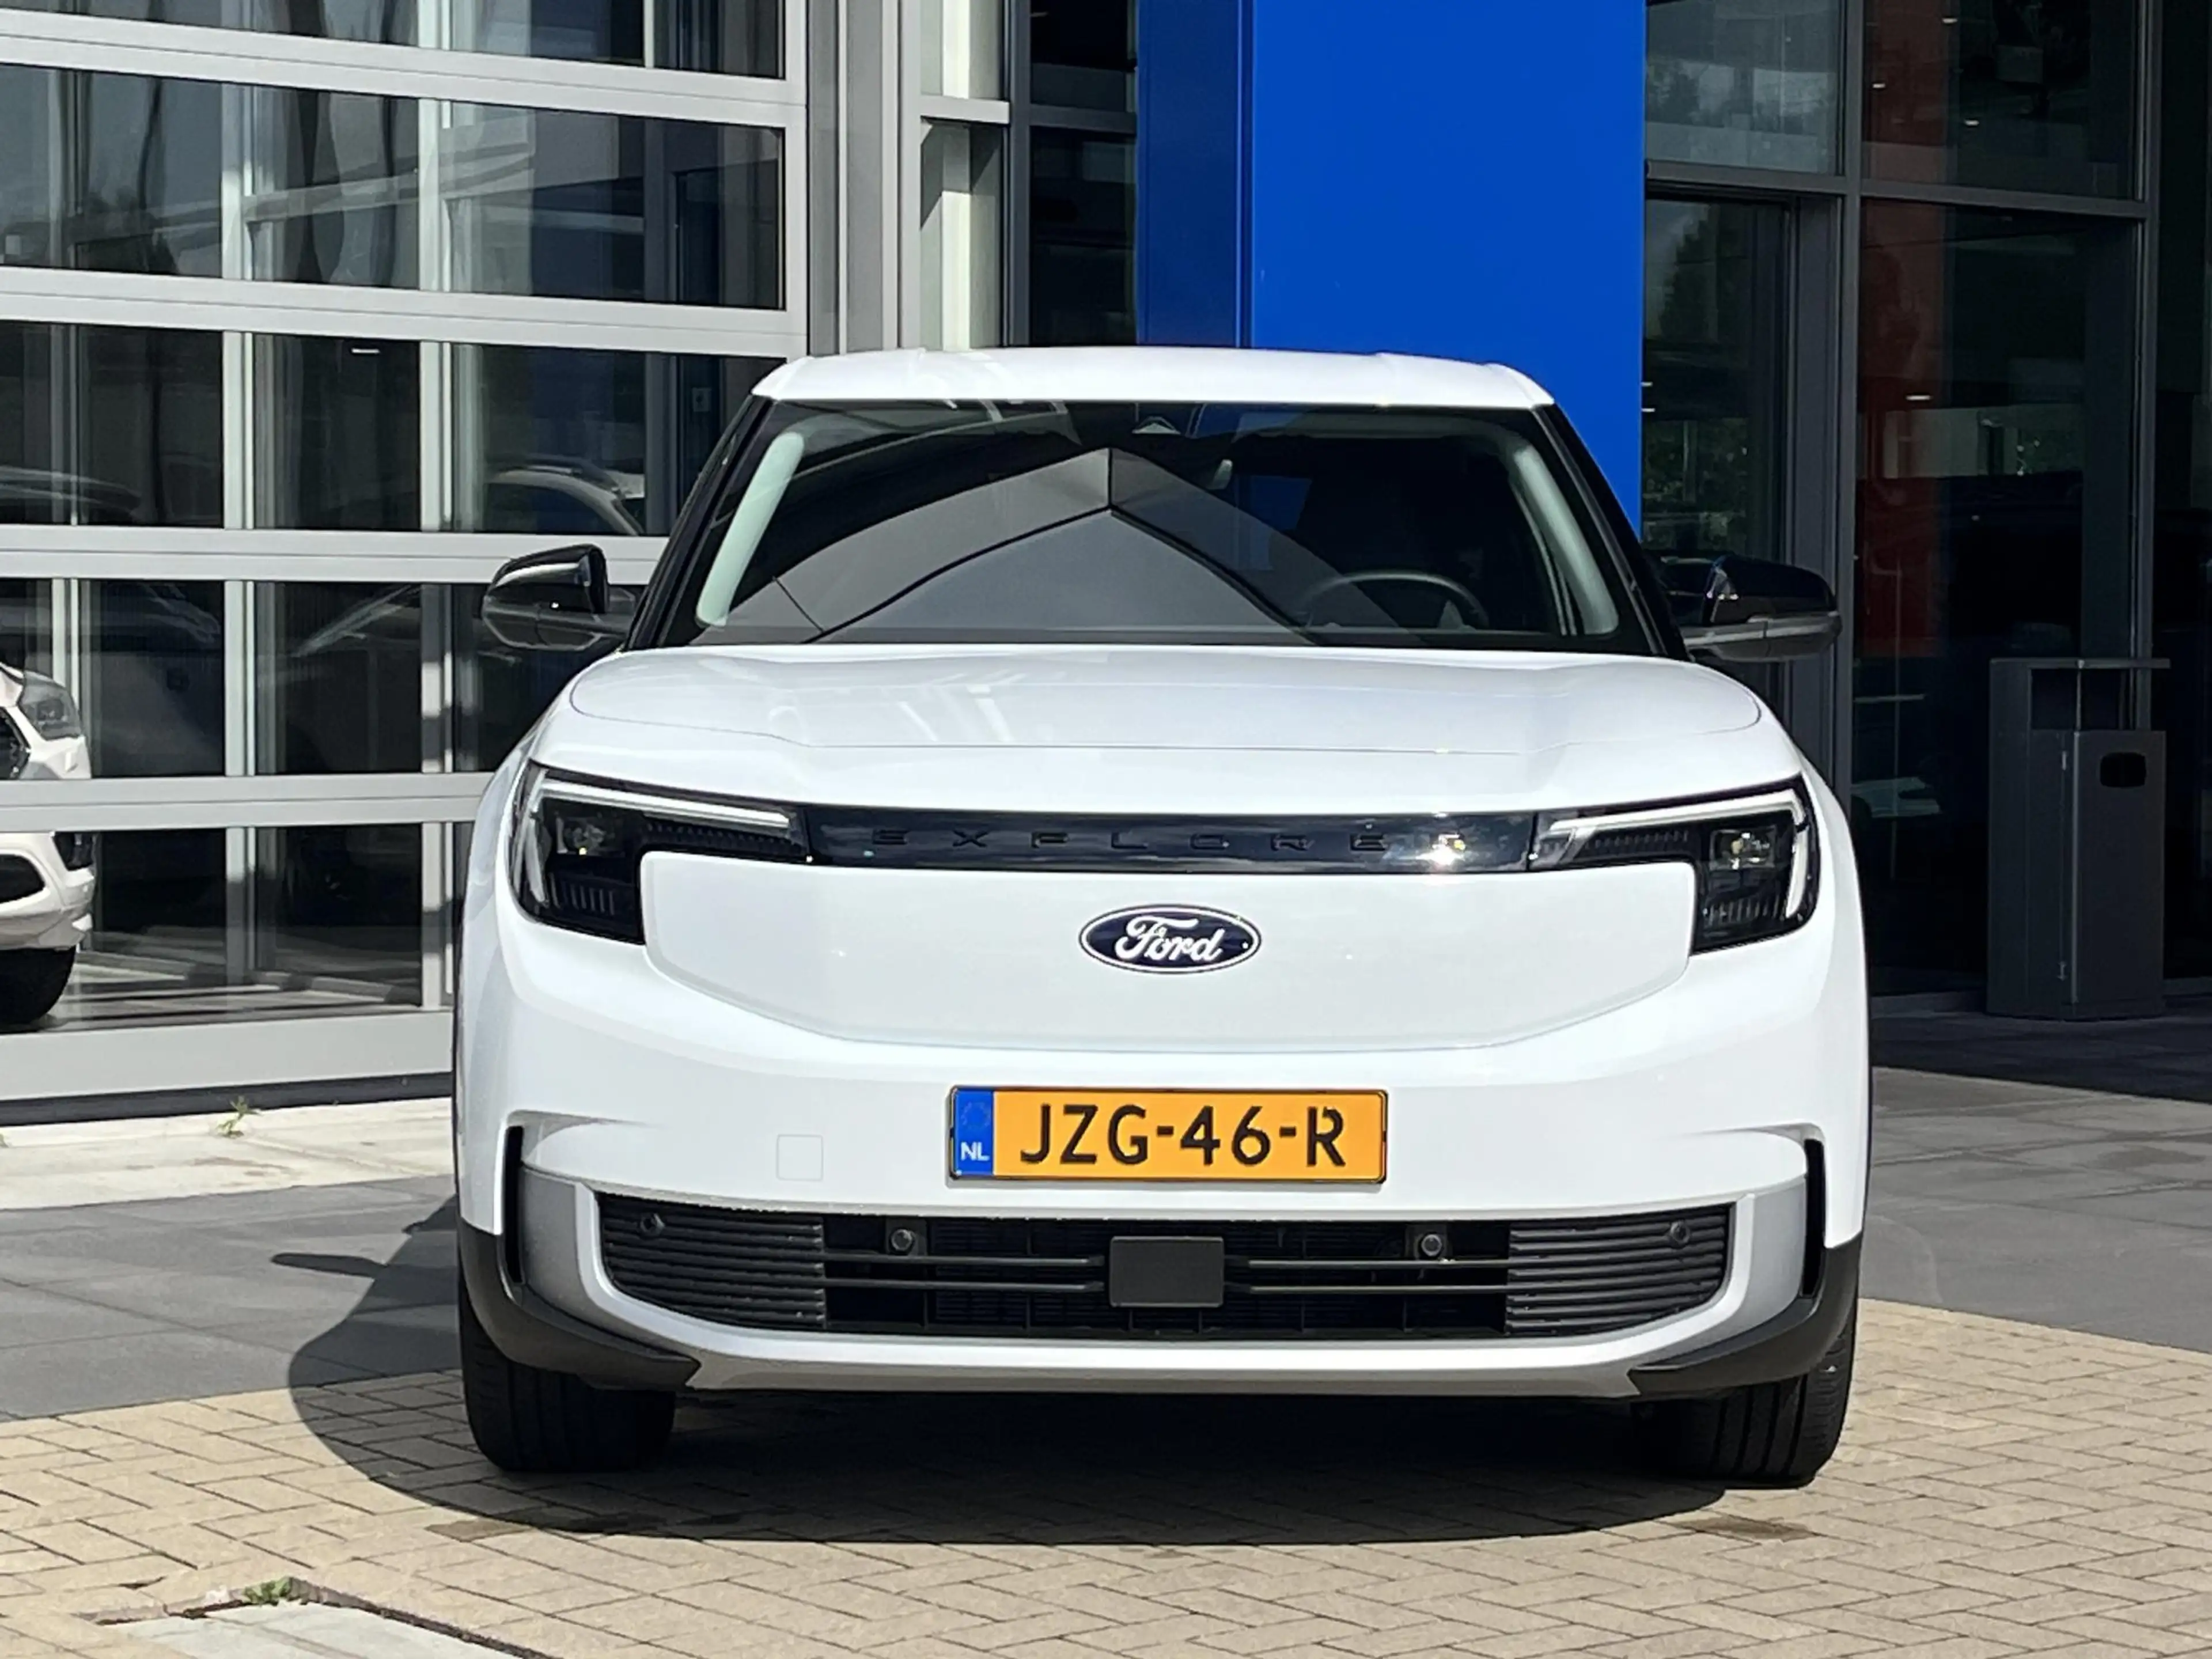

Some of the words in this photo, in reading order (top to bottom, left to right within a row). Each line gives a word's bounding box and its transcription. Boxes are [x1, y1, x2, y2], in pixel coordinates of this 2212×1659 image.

[1115, 915, 1225, 961] Ford
[961, 1141, 990, 1161] NL
[1020, 1104, 1346, 1167] JZG-46-R
